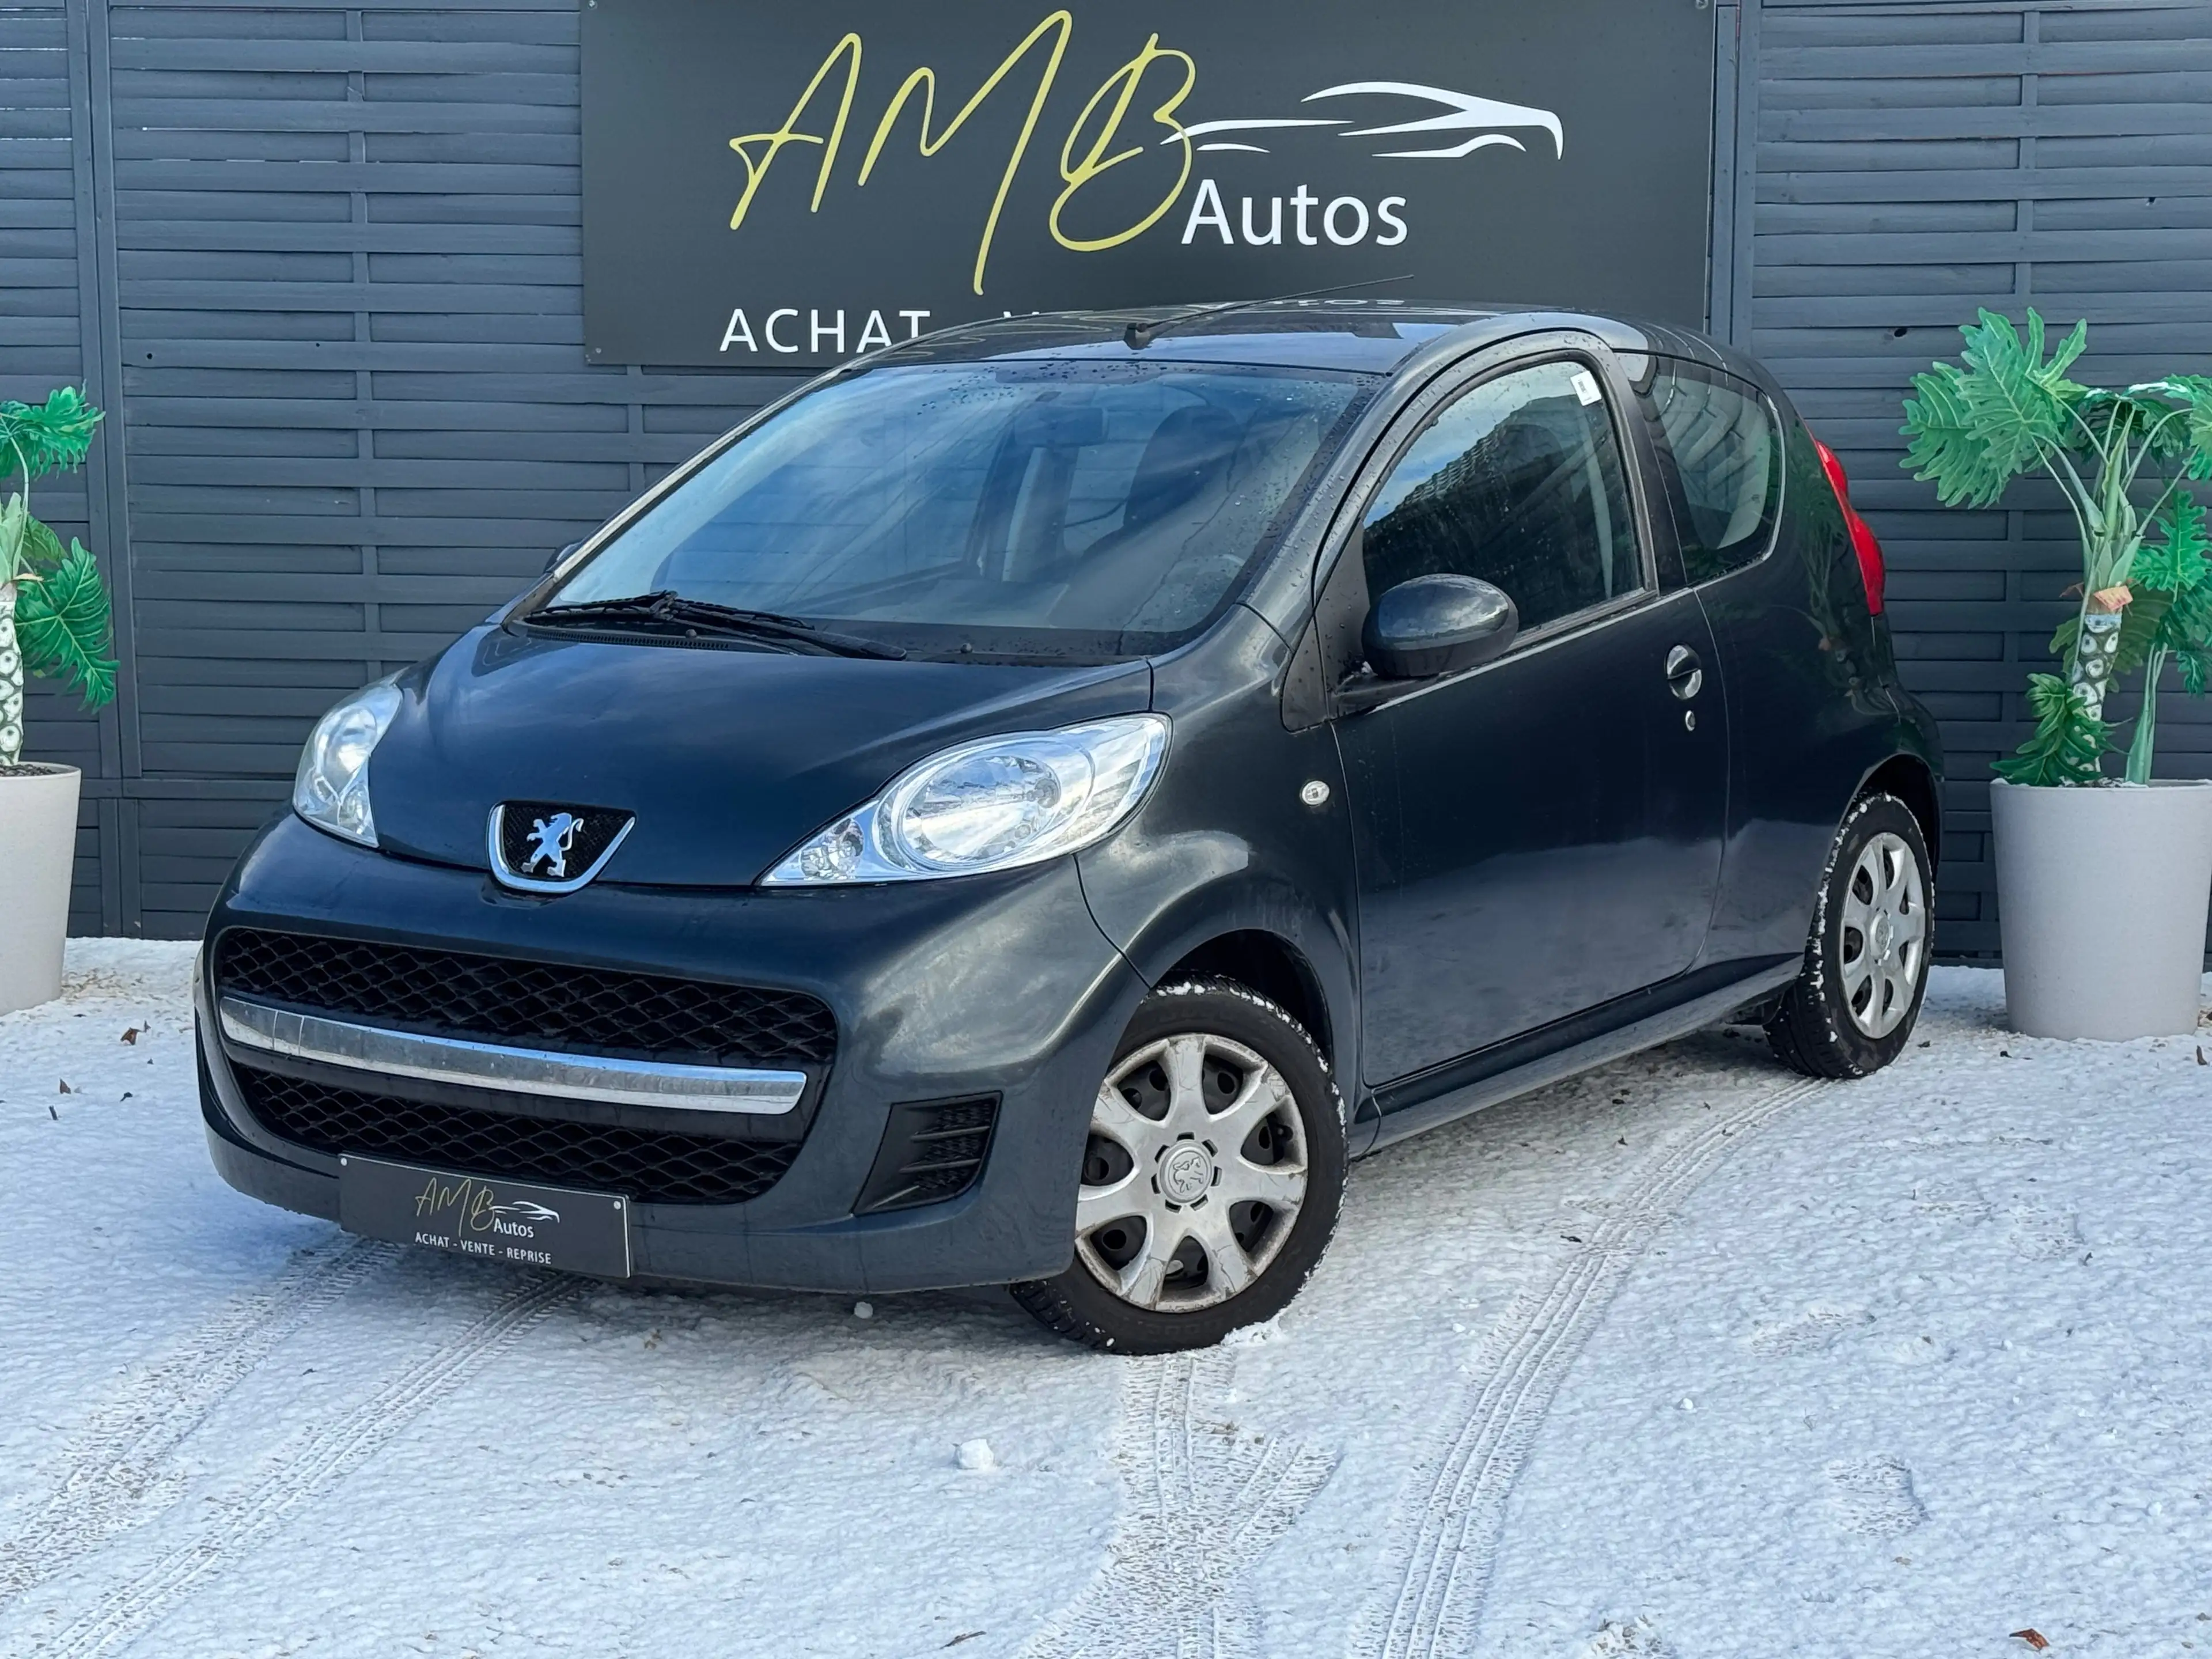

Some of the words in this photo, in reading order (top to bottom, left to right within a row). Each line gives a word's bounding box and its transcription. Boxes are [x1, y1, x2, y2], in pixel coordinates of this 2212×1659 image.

[729, 10, 1196, 296] AMB
[1181, 179, 1408, 247] Autos
[719, 308, 931, 354] ACHAT
[415, 1177, 495, 1238] AMB
[493, 1217, 535, 1238] Autos
[415, 1232, 449, 1248] ACHAT
[460, 1239, 496, 1256] VENTE
[506, 1247, 551, 1264] REPRISE
